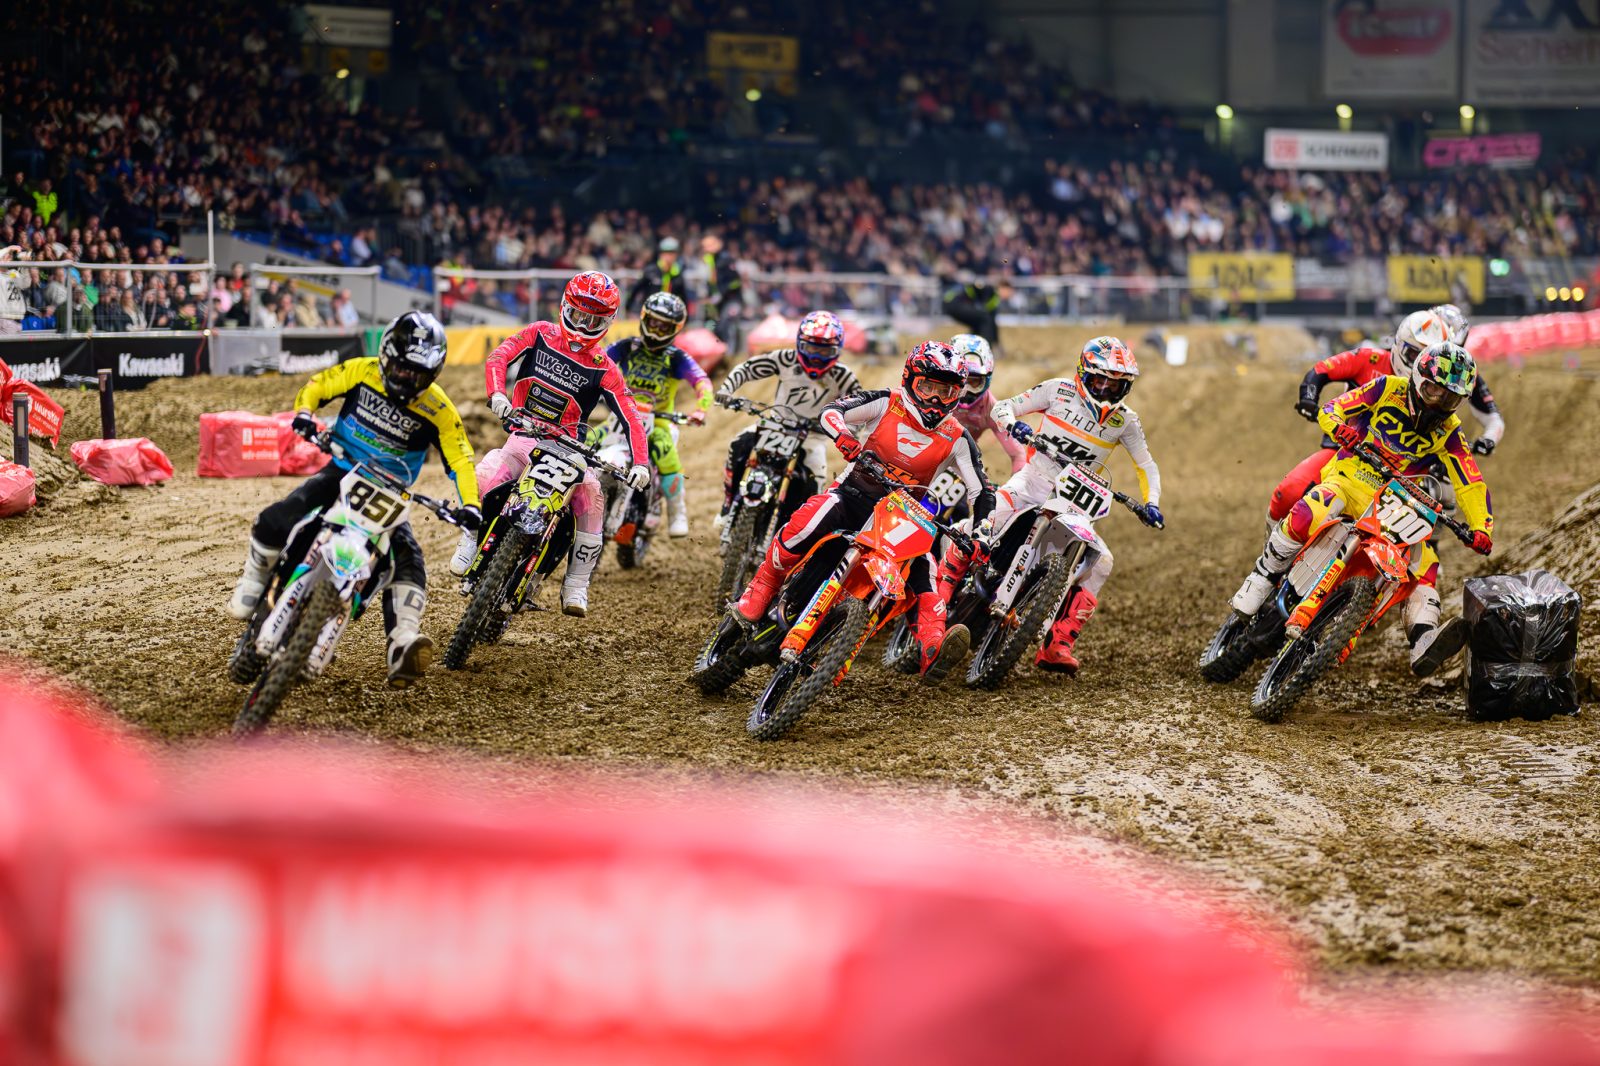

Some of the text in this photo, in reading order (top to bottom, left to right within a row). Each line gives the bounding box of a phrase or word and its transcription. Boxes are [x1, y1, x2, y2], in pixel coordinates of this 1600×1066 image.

[10, 357, 61, 382] wasaki
[119, 353, 184, 377] Kawasaki
[785, 386, 830, 408] FLY
[755, 429, 800, 455] 129
[1041, 433, 1097, 466] KTM
[1376, 411, 1433, 454] FXR
[349, 480, 406, 528] 851
[929, 471, 968, 507] 89
[1059, 475, 1104, 518] 301
[883, 517, 919, 547] 1
[1376, 494, 1432, 545] 300
[1006, 549, 1029, 593] DULOP
[271, 582, 304, 634] DULOP
